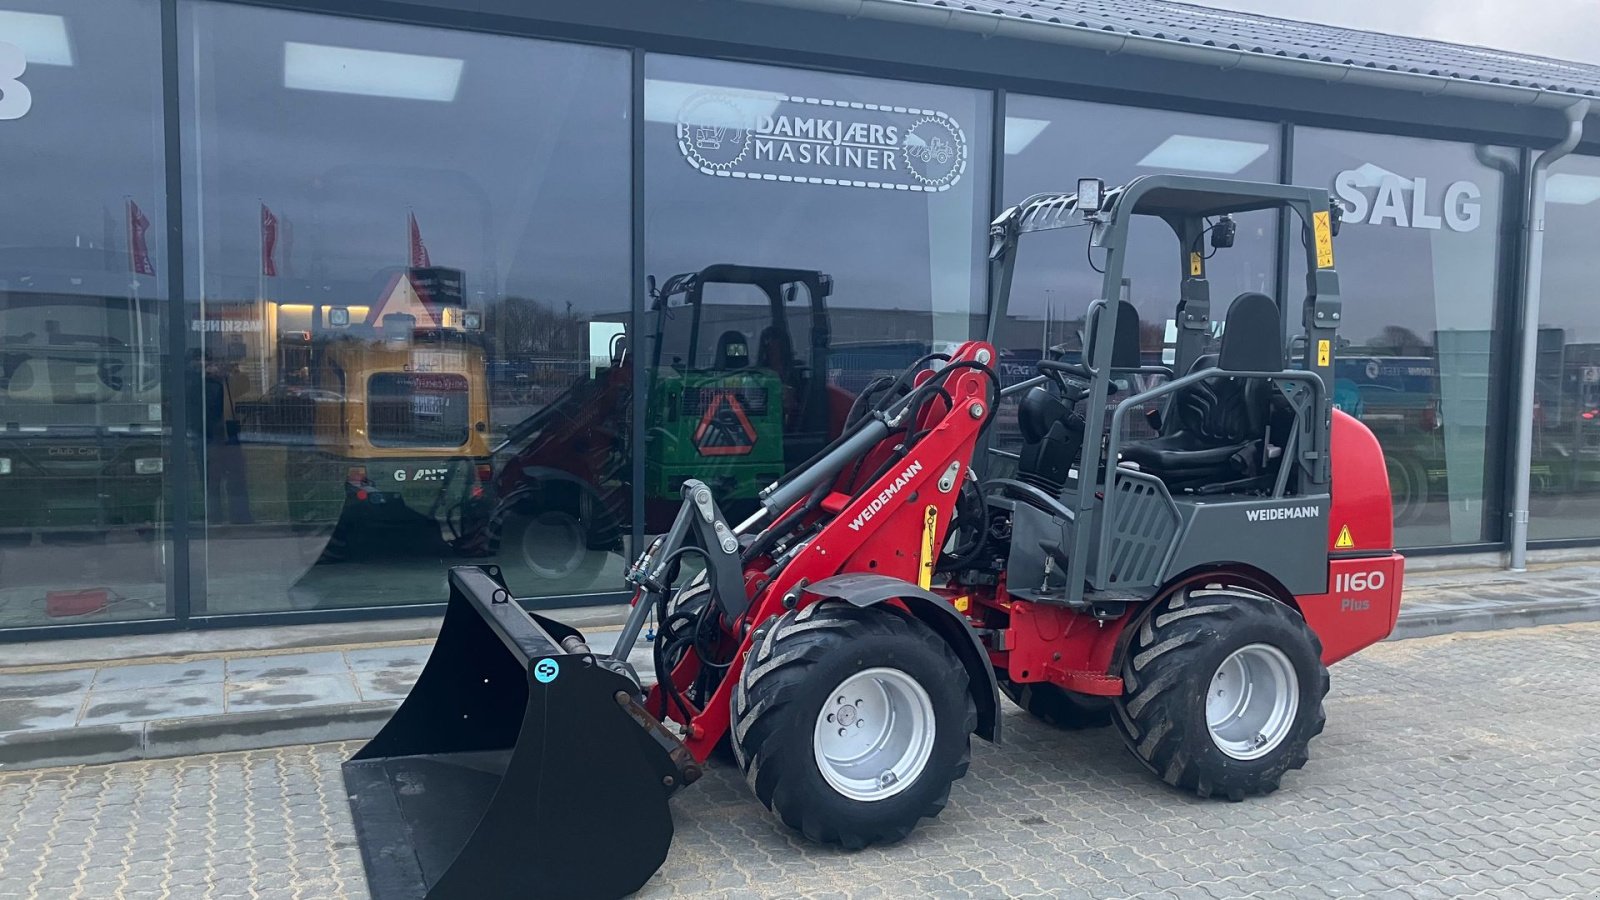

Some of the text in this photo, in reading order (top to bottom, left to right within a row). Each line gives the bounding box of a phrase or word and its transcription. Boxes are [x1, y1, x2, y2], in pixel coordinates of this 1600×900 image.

[756, 115, 898, 146] DAMKJÆRS
[755, 140, 897, 171] MASKINER
[1335, 169, 1481, 232] SALG
[848, 459, 923, 531] WEIDEMANN
[1246, 505, 1319, 522] WEIDEMANN
[1336, 571, 1385, 593] 1160
[1341, 599, 1370, 612] Plus
